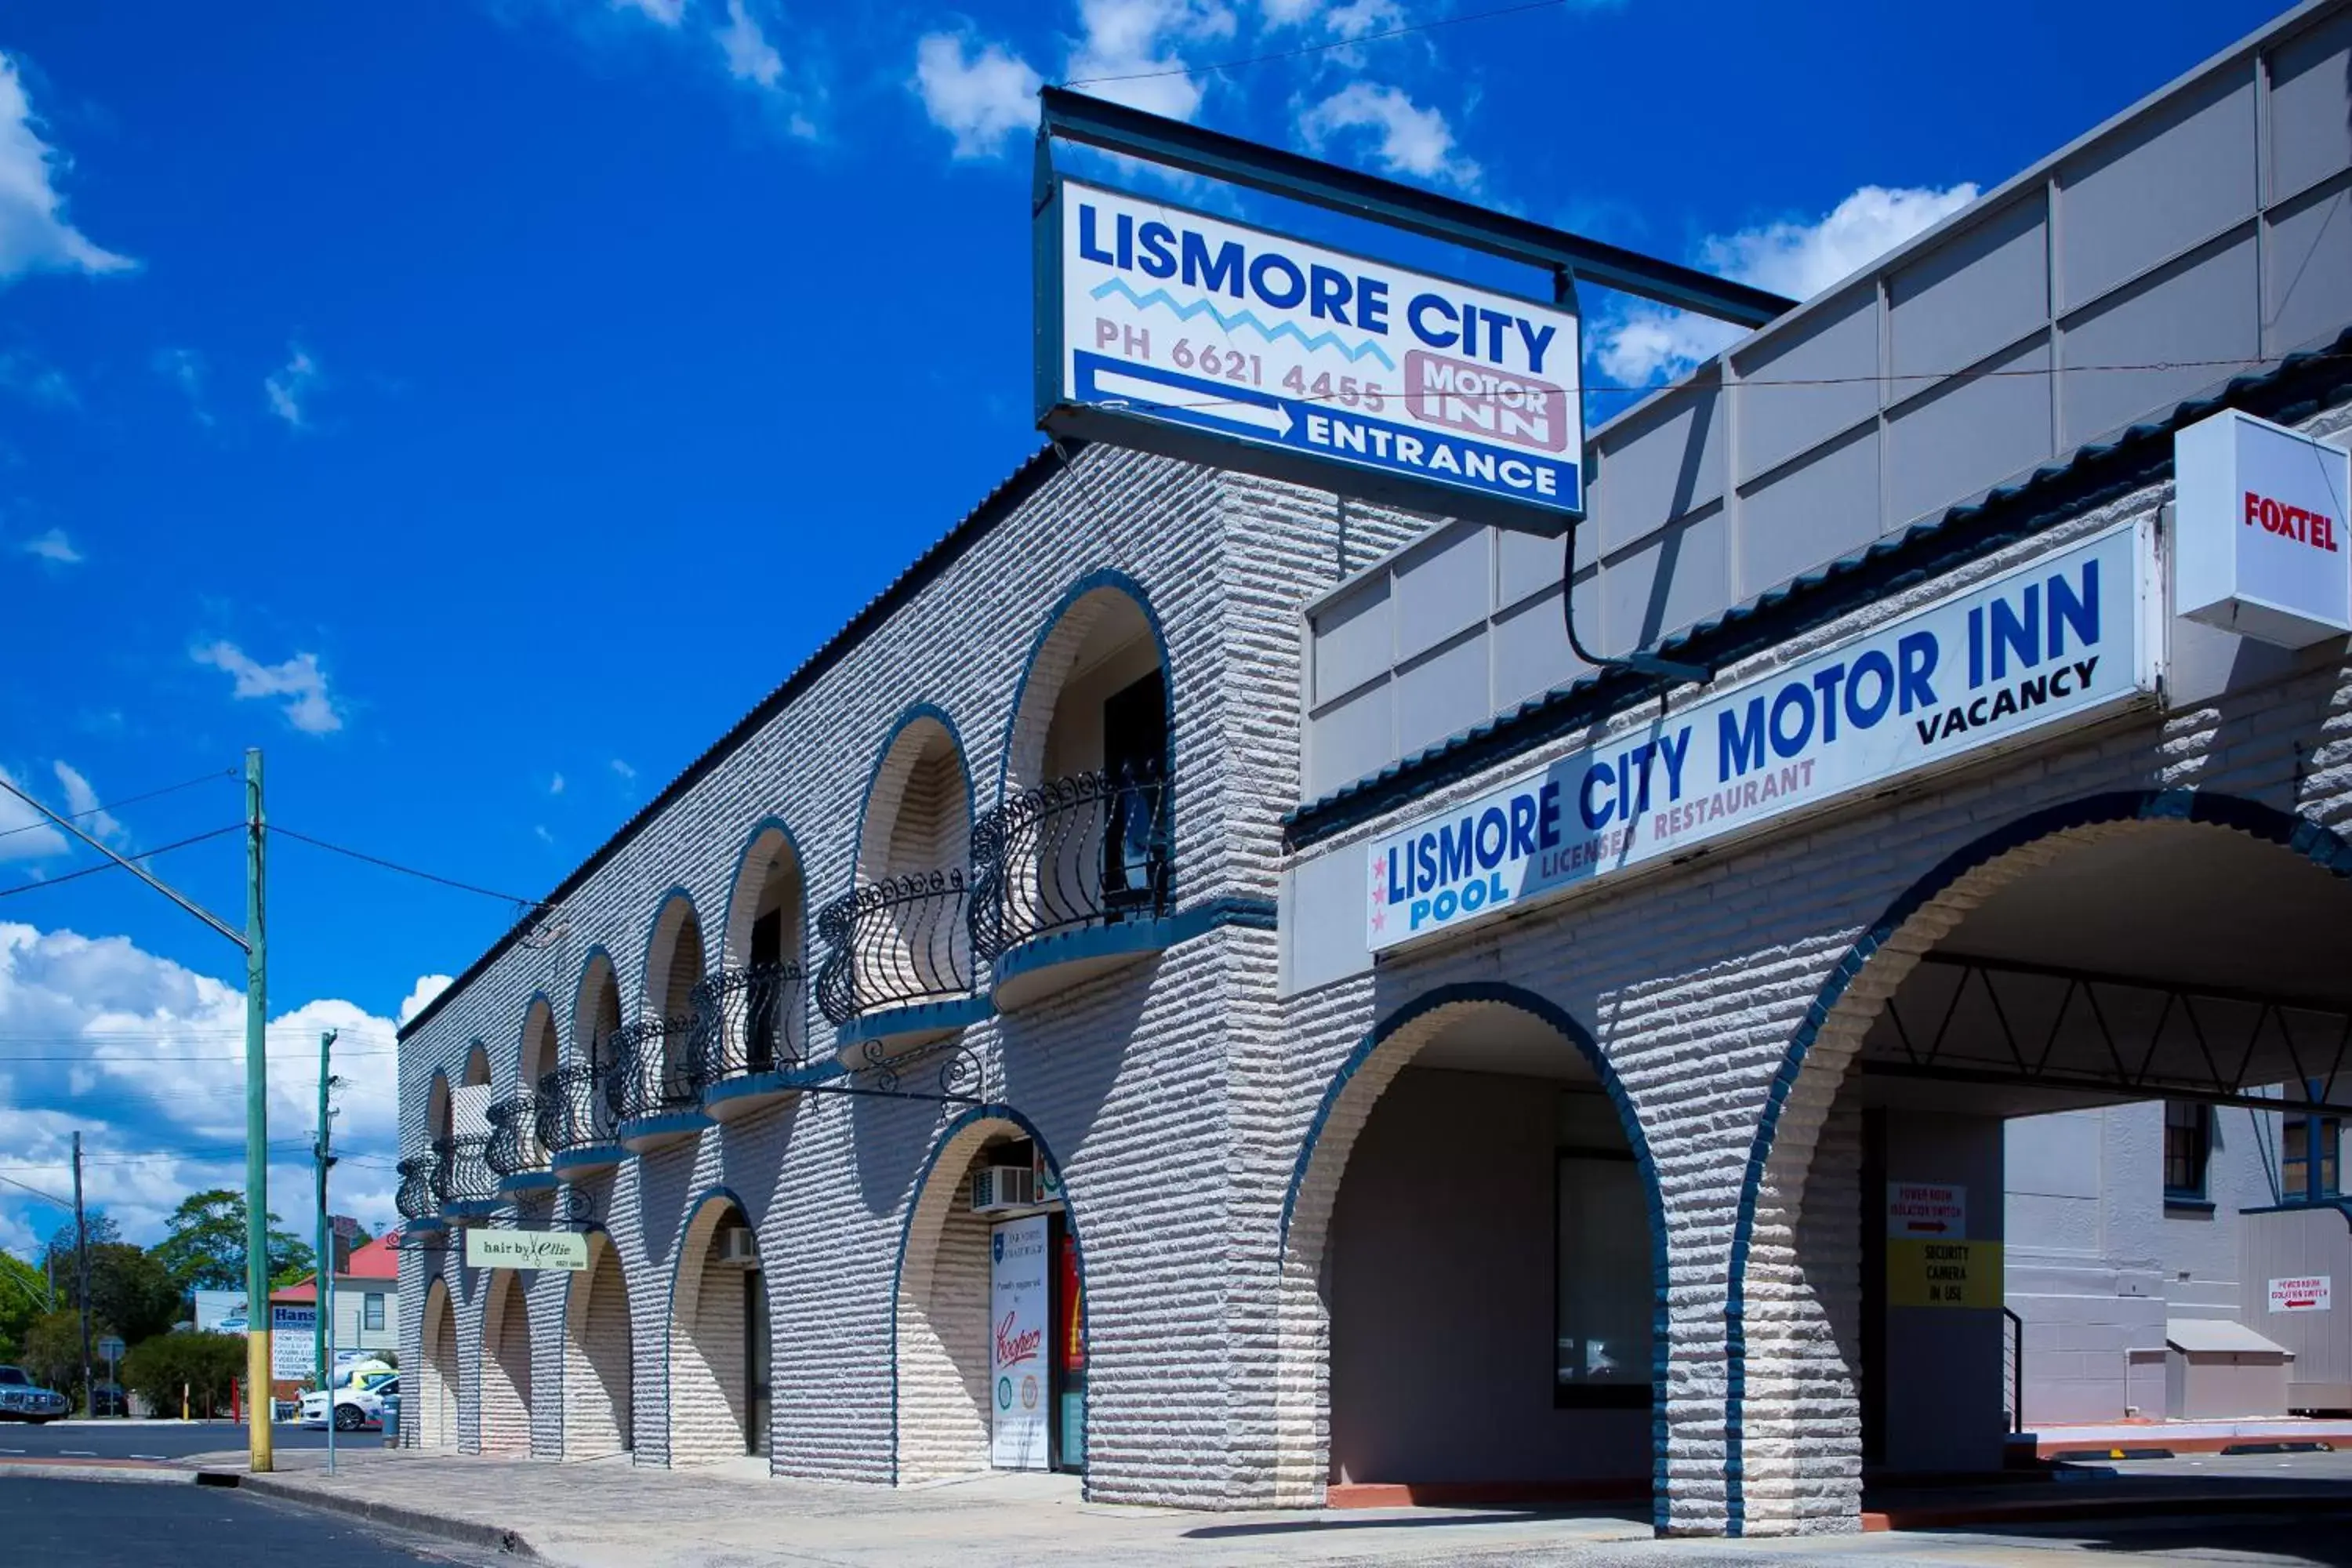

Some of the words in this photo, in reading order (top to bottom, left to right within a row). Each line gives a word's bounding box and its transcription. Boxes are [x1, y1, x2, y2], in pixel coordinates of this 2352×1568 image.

[1080, 203, 1388, 336] LISMORE
[1407, 292, 1556, 374] CITY
[1095, 317, 1151, 361] PH
[1172, 337, 1263, 387] 6621
[1282, 363, 1385, 414] 4455
[1423, 358, 1548, 416] MOTOR
[1423, 395, 1550, 445] INN
[1307, 415, 1557, 497] ENTRANCE
[2245, 491, 2338, 552] FOXTEL
[1917, 655, 2099, 745] VACANCY
[1388, 781, 1560, 905] LISMORE
[1580, 724, 1692, 832] CITY
[1718, 630, 1939, 783] MOTOR
[1968, 558, 2100, 690] INN
[1541, 826, 1636, 880] LICENSED
[1654, 759, 1817, 839] RESTAURANT
[1410, 871, 1509, 931] POOL
[485, 1242, 512, 1253] hair
[515, 1243, 529, 1256] by
[1925, 1245, 1970, 1260] SECURITY
[1926, 1265, 1967, 1280] CAMERA
[1929, 1286, 1940, 1301] IN
[1945, 1286, 1962, 1301] USE
